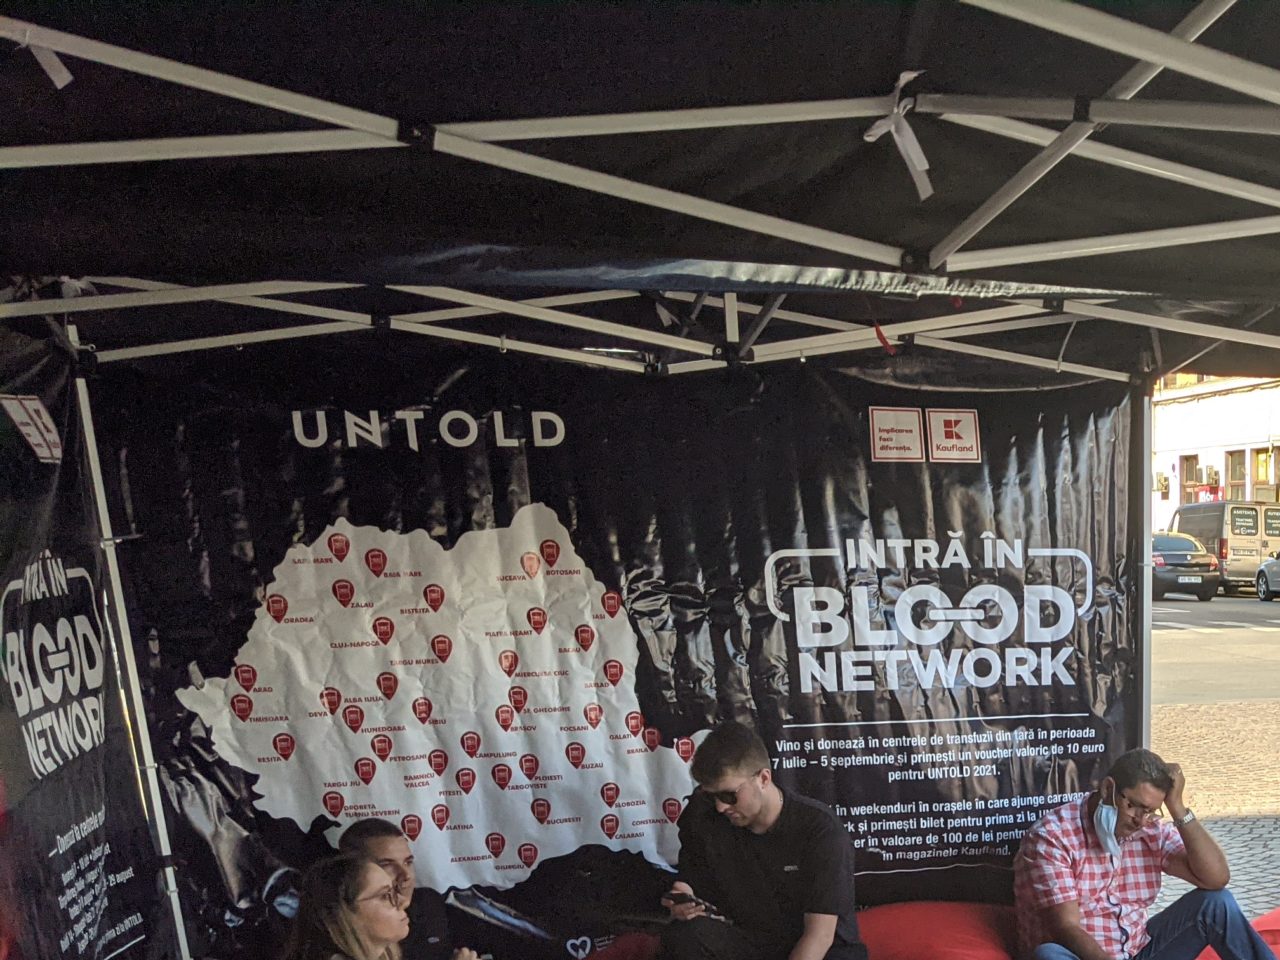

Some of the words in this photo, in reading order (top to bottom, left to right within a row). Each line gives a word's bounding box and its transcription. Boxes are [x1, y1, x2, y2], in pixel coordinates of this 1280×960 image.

[291, 410, 566, 453] UNTOLD
[936, 443, 974, 453] Kaufland
[846, 530, 972, 570] INTRĂ
[983, 531, 1024, 569] ÎN
[545, 568, 581, 576] BOTOSANI
[400, 607, 430, 615] BISTRITA
[284, 616, 315, 624] ORADEA
[793, 583, 1076, 649] BLOOD
[329, 639, 380, 649] CLUJ-NAPOCA
[6, 614, 105, 719] BLOOD
[798, 646, 1077, 694] NETWORK
[552, 669, 569, 677] CIUC
[343, 696, 364, 704] ALBA
[308, 710, 329, 718] DEVA
[249, 715, 290, 723] TIMISOARA
[361, 725, 407, 734] HUNEDOARA
[559, 724, 589, 732] FOCSANI
[609, 733, 632, 741] GALATI
[775, 740, 801, 752] Vino
[803, 740, 815, 754] și
[817, 737, 865, 750] donează
[868, 736, 880, 748] în
[882, 734, 927, 747] centrele
[930, 733, 944, 745] de
[946, 731, 993, 744] transfuzii
[995, 730, 1012, 742] din
[1037, 728, 1048, 740] în
[1050, 727, 1096, 742] perioada
[474, 751, 517, 759] CAMPULUNG
[626, 747, 649, 755] BRAILA
[389, 753, 427, 762] PETROSANI
[772, 758, 780, 770] 7
[782, 756, 807, 769] iulie
[820, 755, 829, 767] 5
[830, 752, 895, 768] septembrie
[897, 752, 908, 767] și
[910, 749, 956, 766] primești
[958, 750, 973, 761] un
[975, 746, 1013, 760] voucher
[1015, 745, 1050, 757] valoric
[1051, 743, 1064, 755] de
[1066, 743, 1080, 754] 10
[1081, 743, 1106, 753] euro
[581, 762, 604, 770] BUZAU
[403, 772, 435, 781] RAMNICU
[534, 774, 563, 782] PLOIESTI
[888, 769, 925, 784] pentru
[926, 766, 971, 780] UNTOLD
[973, 765, 1001, 777] 2021.
[404, 781, 430, 789] VALCEA
[507, 783, 547, 791] TARGOVISTE
[344, 803, 376, 811] DROBETA
[614, 800, 647, 808] SLOBOZIA
[835, 804, 847, 817] în
[850, 802, 916, 816] weekenduri
[918, 801, 930, 813] în
[932, 799, 973, 814] orașele
[975, 798, 985, 810] în
[987, 798, 1009, 810] care
[1011, 795, 1045, 809] ajunge
[370, 809, 400, 817] SEVERIN
[631, 818, 668, 826] CONSTANTA
[858, 819, 868, 834] și
[870, 818, 917, 833] primești
[920, 816, 945, 829] bilet
[947, 814, 983, 830] pentru
[985, 812, 1015, 828] prima
[1016, 812, 1025, 823] zi
[1027, 810, 1037, 822] la
[868, 834, 879, 848] în
[881, 834, 923, 846] valoare
[925, 833, 939, 844] de
[941, 832, 962, 844] 100
[965, 831, 980, 843] de
[981, 830, 994, 842] lei
[882, 851, 893, 861] în
[896, 846, 958, 861] magazinele
[450, 854, 492, 863] ALEXANDRIA
